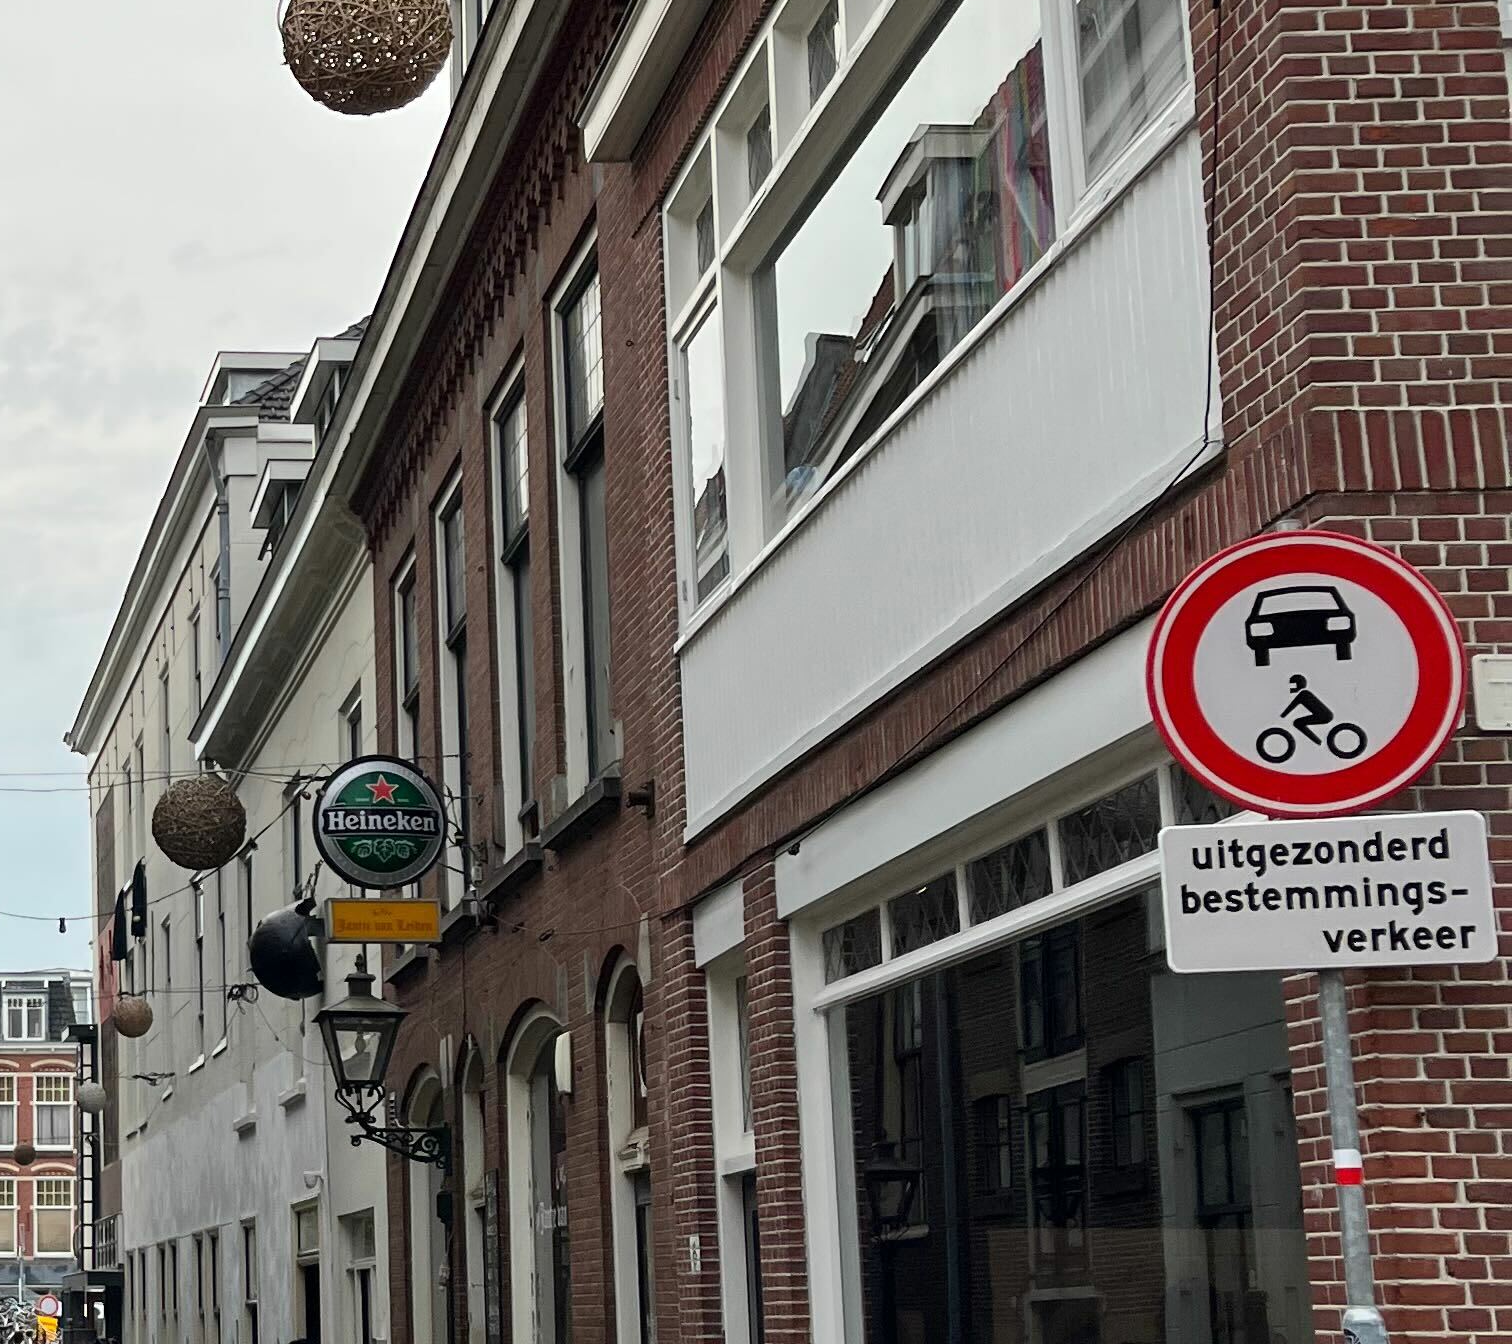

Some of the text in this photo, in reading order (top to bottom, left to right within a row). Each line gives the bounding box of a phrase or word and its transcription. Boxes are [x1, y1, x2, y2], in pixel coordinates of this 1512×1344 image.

[327, 810, 436, 832] Heineken
[1191, 828, 1449, 877] uitgezonderd
[1180, 877, 1469, 916] bestemmings-
[1323, 920, 1476, 953] verkeer
